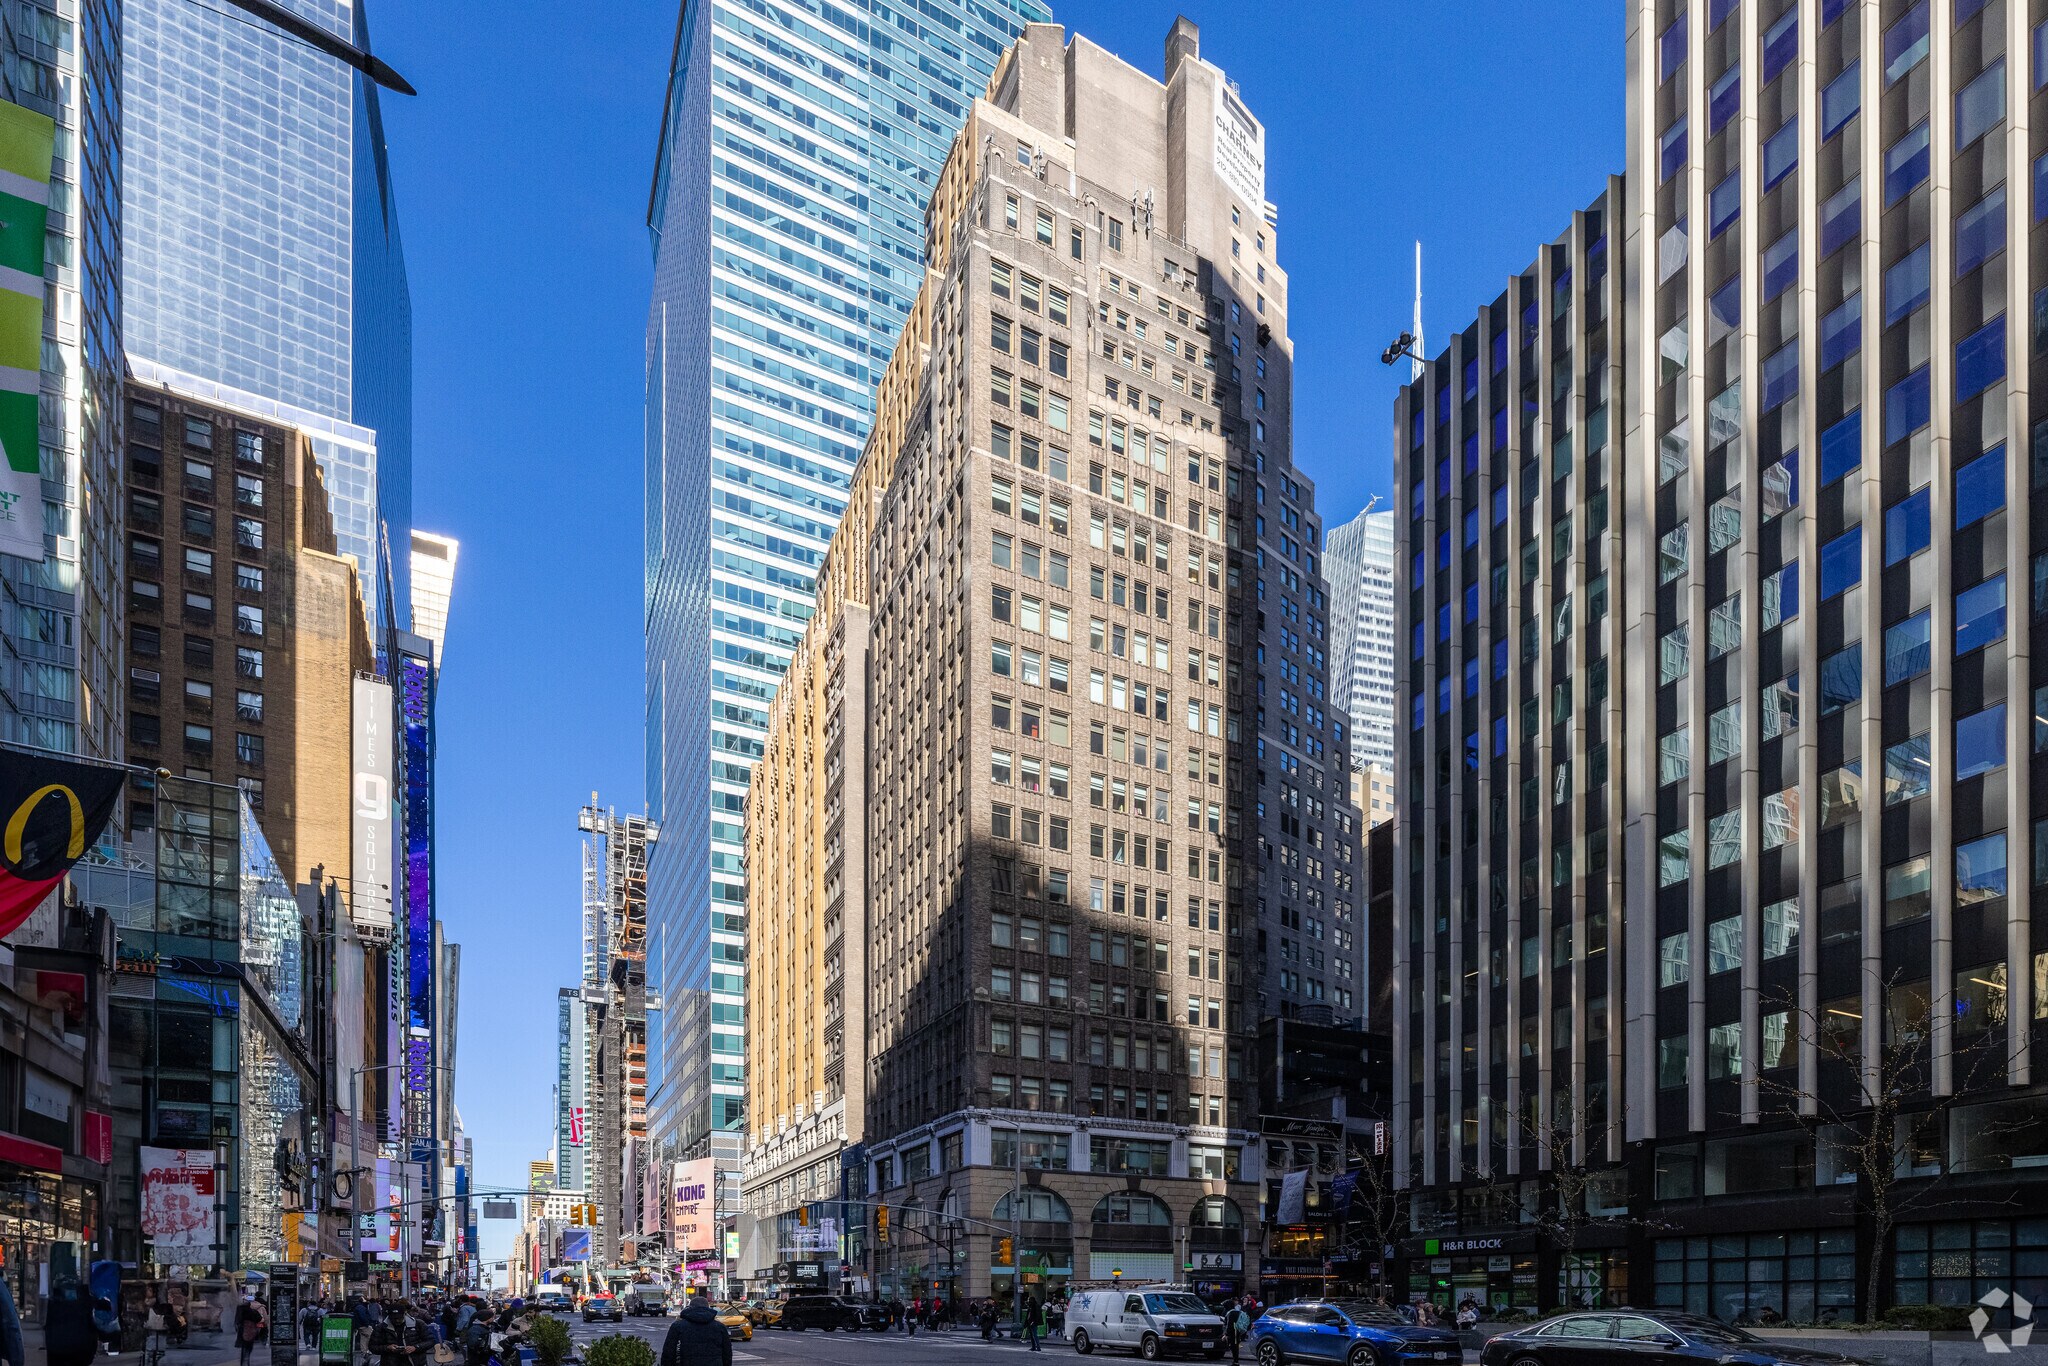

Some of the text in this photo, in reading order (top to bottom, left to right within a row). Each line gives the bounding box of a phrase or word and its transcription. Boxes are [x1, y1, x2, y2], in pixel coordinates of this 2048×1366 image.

[1216, 115, 1262, 171] CHARNEY
[1231, 120, 1249, 146] L.H.
[1217, 145, 1259, 195] Development
[366, 689, 377, 768] TIMES
[365, 825, 376, 919] SQUARE
[390, 922, 398, 1022] STARBUCKS
[675, 1202, 700, 1216] EMPIRE
[677, 1183, 706, 1203] KONG
[675, 1225, 690, 1234] MARCH
[1442, 1239, 1502, 1251] H&R BLOCK
